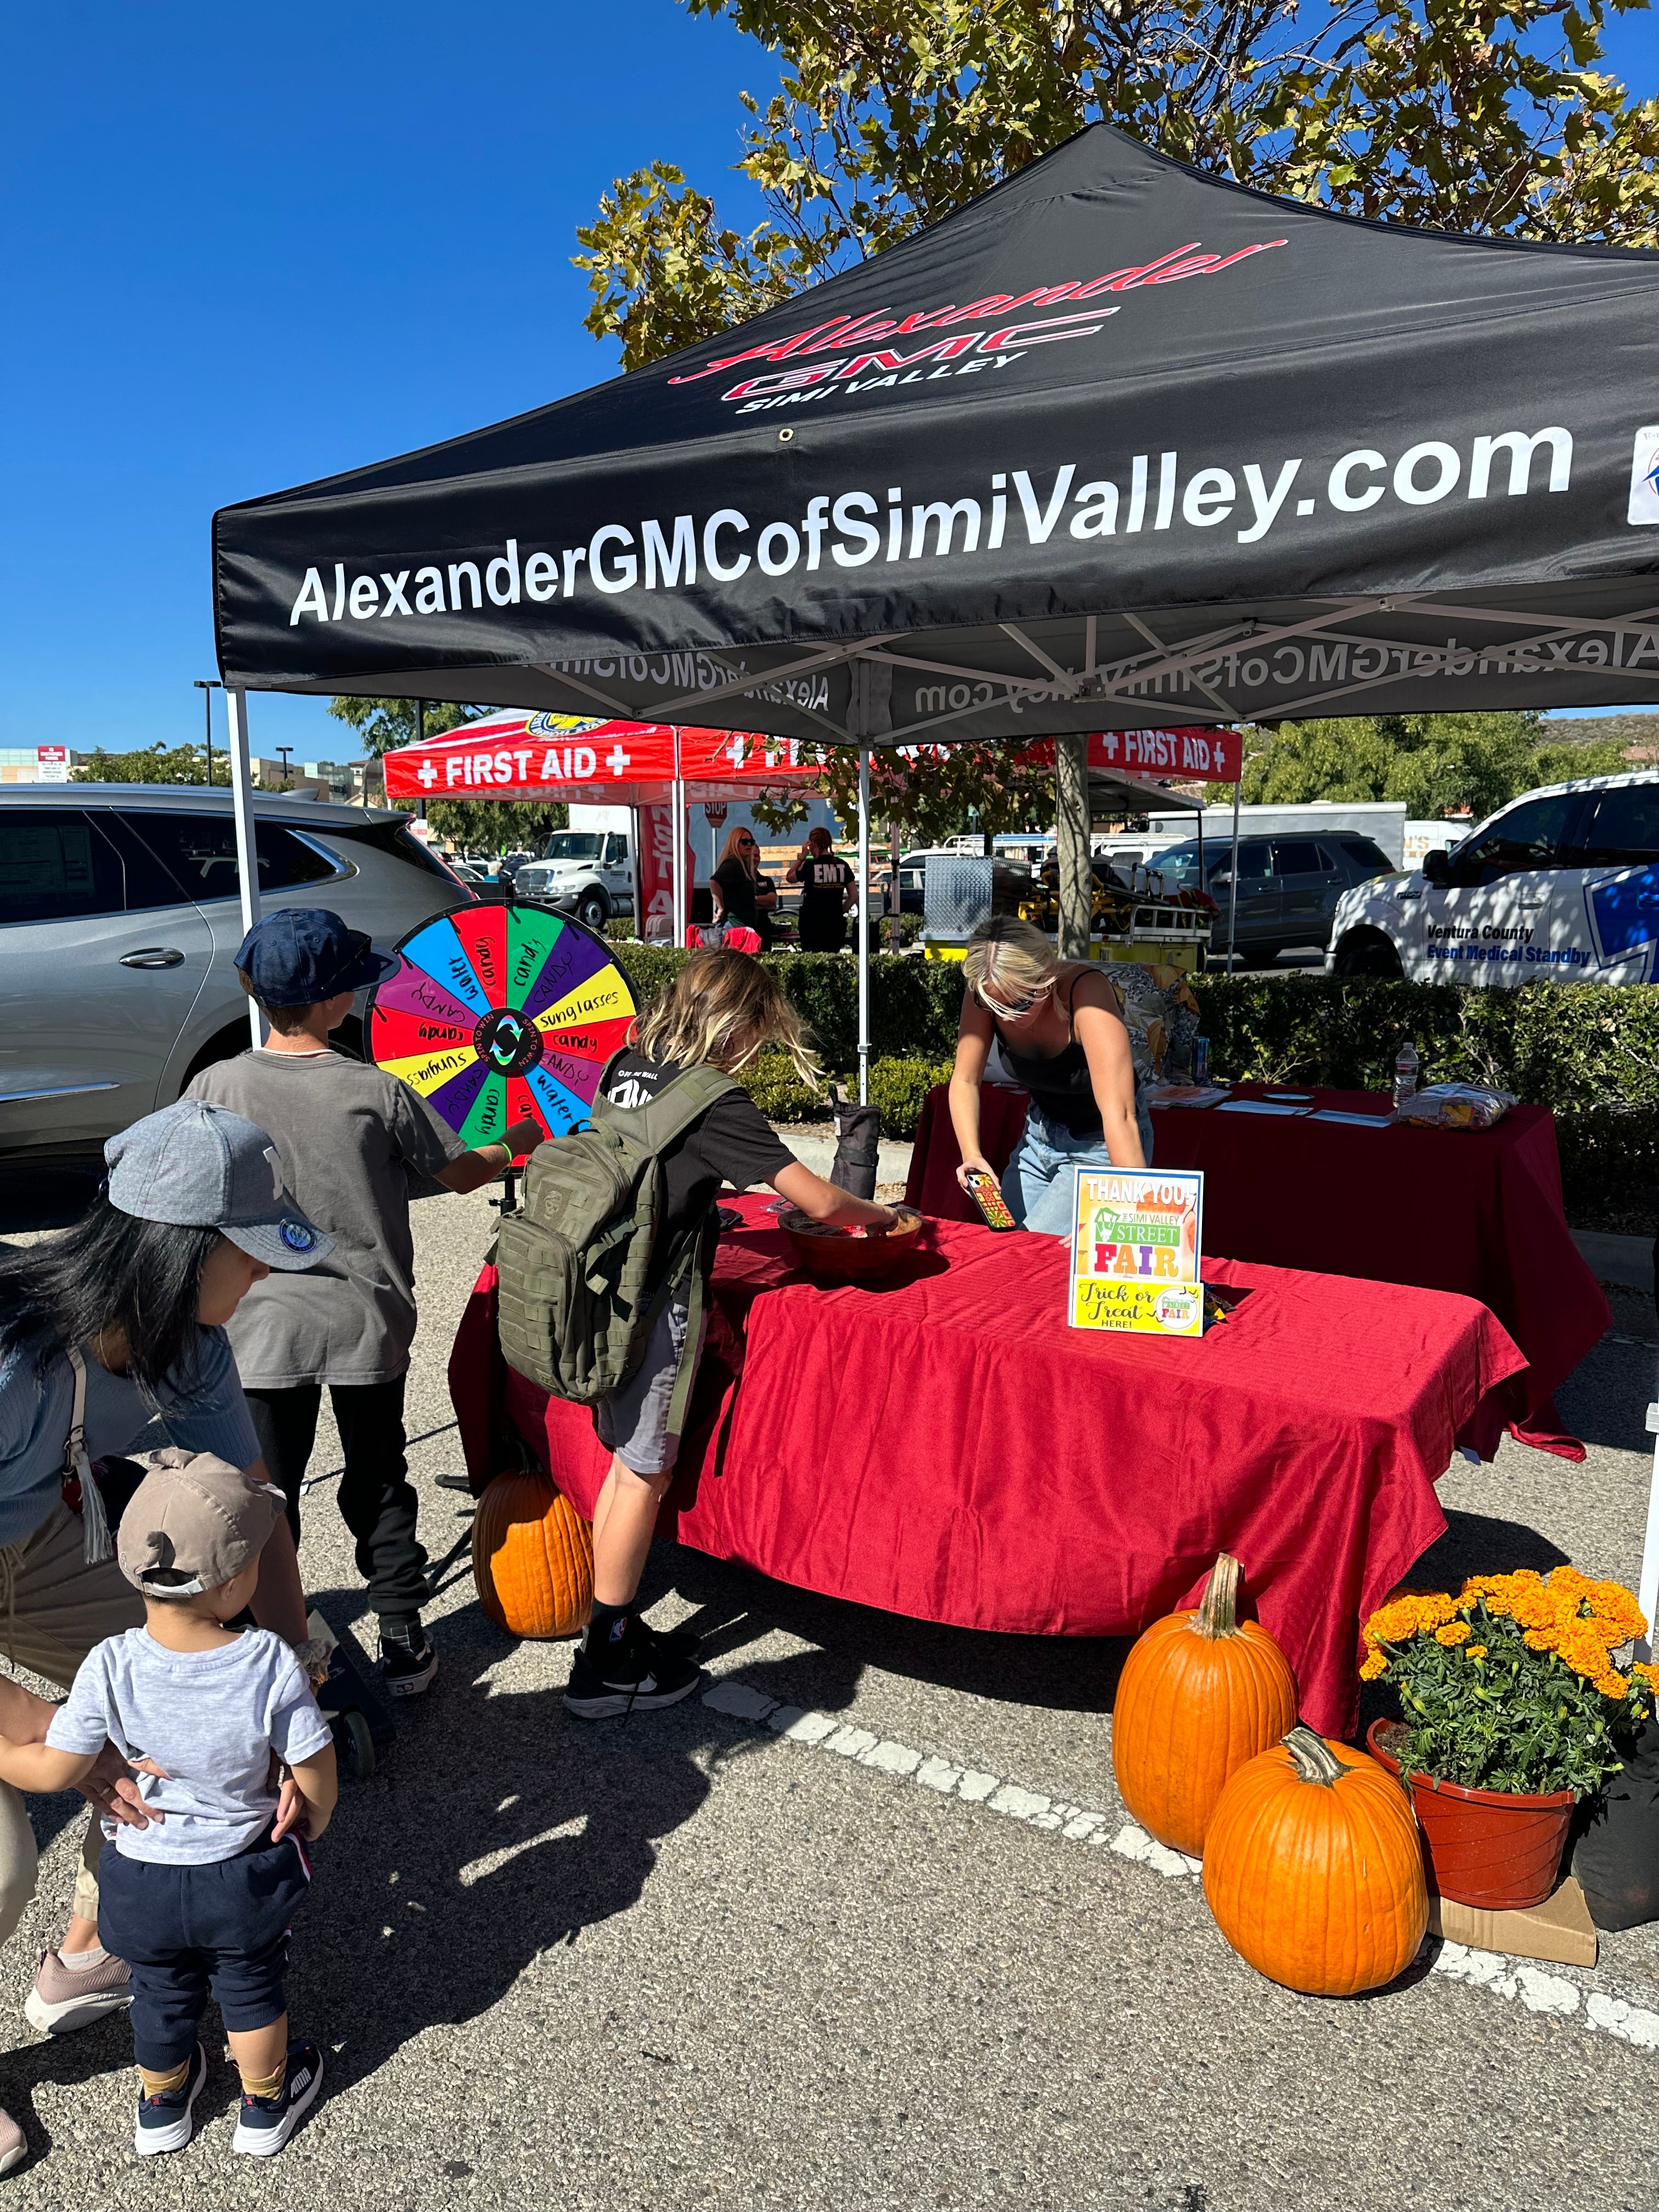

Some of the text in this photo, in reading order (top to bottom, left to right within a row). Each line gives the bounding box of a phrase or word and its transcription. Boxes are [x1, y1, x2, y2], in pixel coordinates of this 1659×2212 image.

[668, 239, 1288, 384] Alexander
[721, 306, 1121, 402] GMC
[735, 351, 1028, 414] SIMI VALLEY
[289, 426, 1573, 627] AlexanderGMCofSimiValley.com
[1125, 730, 1210, 770] FIRST AID
[446, 747, 597, 787] FIRST AID
[706, 802, 727, 815] STOP
[814, 864, 845, 883] EMT
[1427, 925, 1534, 944] Ventura County
[476, 936, 496, 987] candy
[1427, 944, 1592, 968] Event Medical Standby
[540, 991, 618, 1028] sunglasses
[418, 1022, 464, 1042] candy
[475, 1013, 494, 1062] SPIN TO WIN
[518, 1019, 538, 1066] SPIN TO WIN
[552, 1035, 597, 1052] candy
[406, 1052, 467, 1087] sunglass
[642, 1071, 658, 1080] WALL
[475, 1088, 499, 1136] candy
[518, 1093, 534, 1119] can
[537, 1075, 574, 1122] water
[1087, 1178, 1191, 1206] THANK YOU!
[1128, 1213, 1147, 1223] SIMI
[1150, 1215, 1180, 1225] VALLEY
[1117, 1224, 1177, 1243] STREET
[1094, 1243, 1179, 1277] FAIR
[1079, 1282, 1155, 1304] Trick or
[1086, 1301, 1143, 1320] Treat
[1102, 1319, 1132, 1328] HERE!
[1162, 1308, 1189, 1319] FAIR
